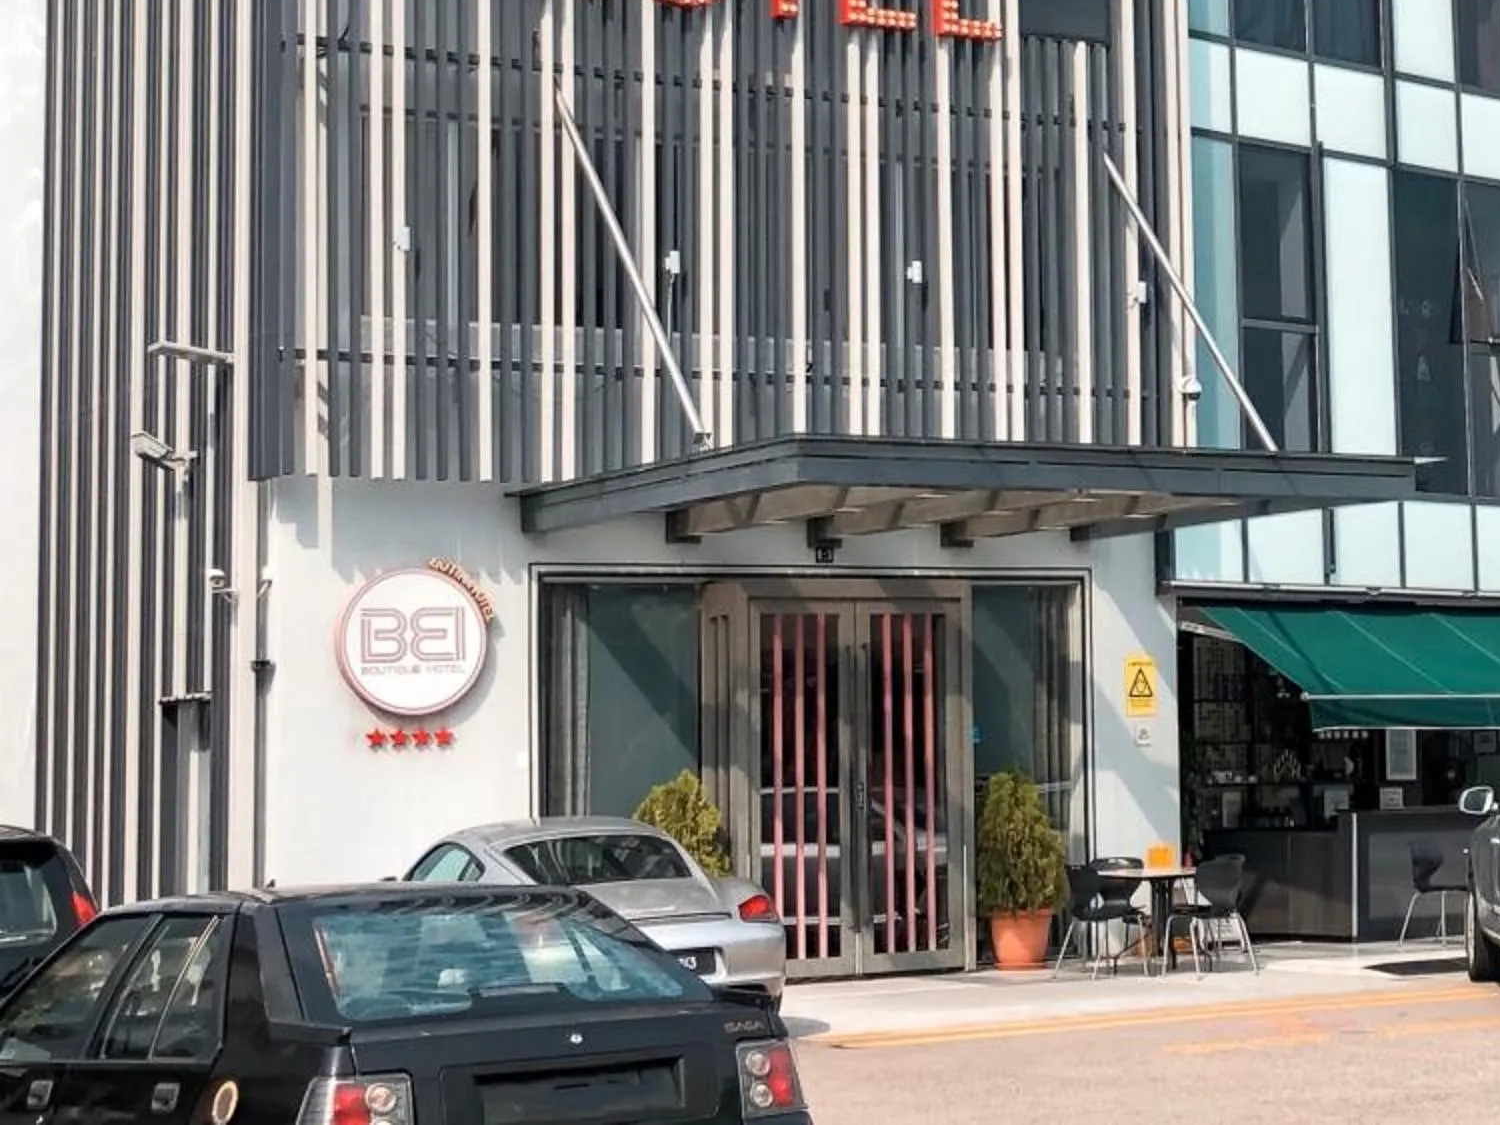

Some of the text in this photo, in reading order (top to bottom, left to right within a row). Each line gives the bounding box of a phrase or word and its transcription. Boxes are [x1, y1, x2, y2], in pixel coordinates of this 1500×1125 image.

[360, 606, 466, 663] BEI
[360, 664, 466, 676] BOUTIQUE HOTEL
